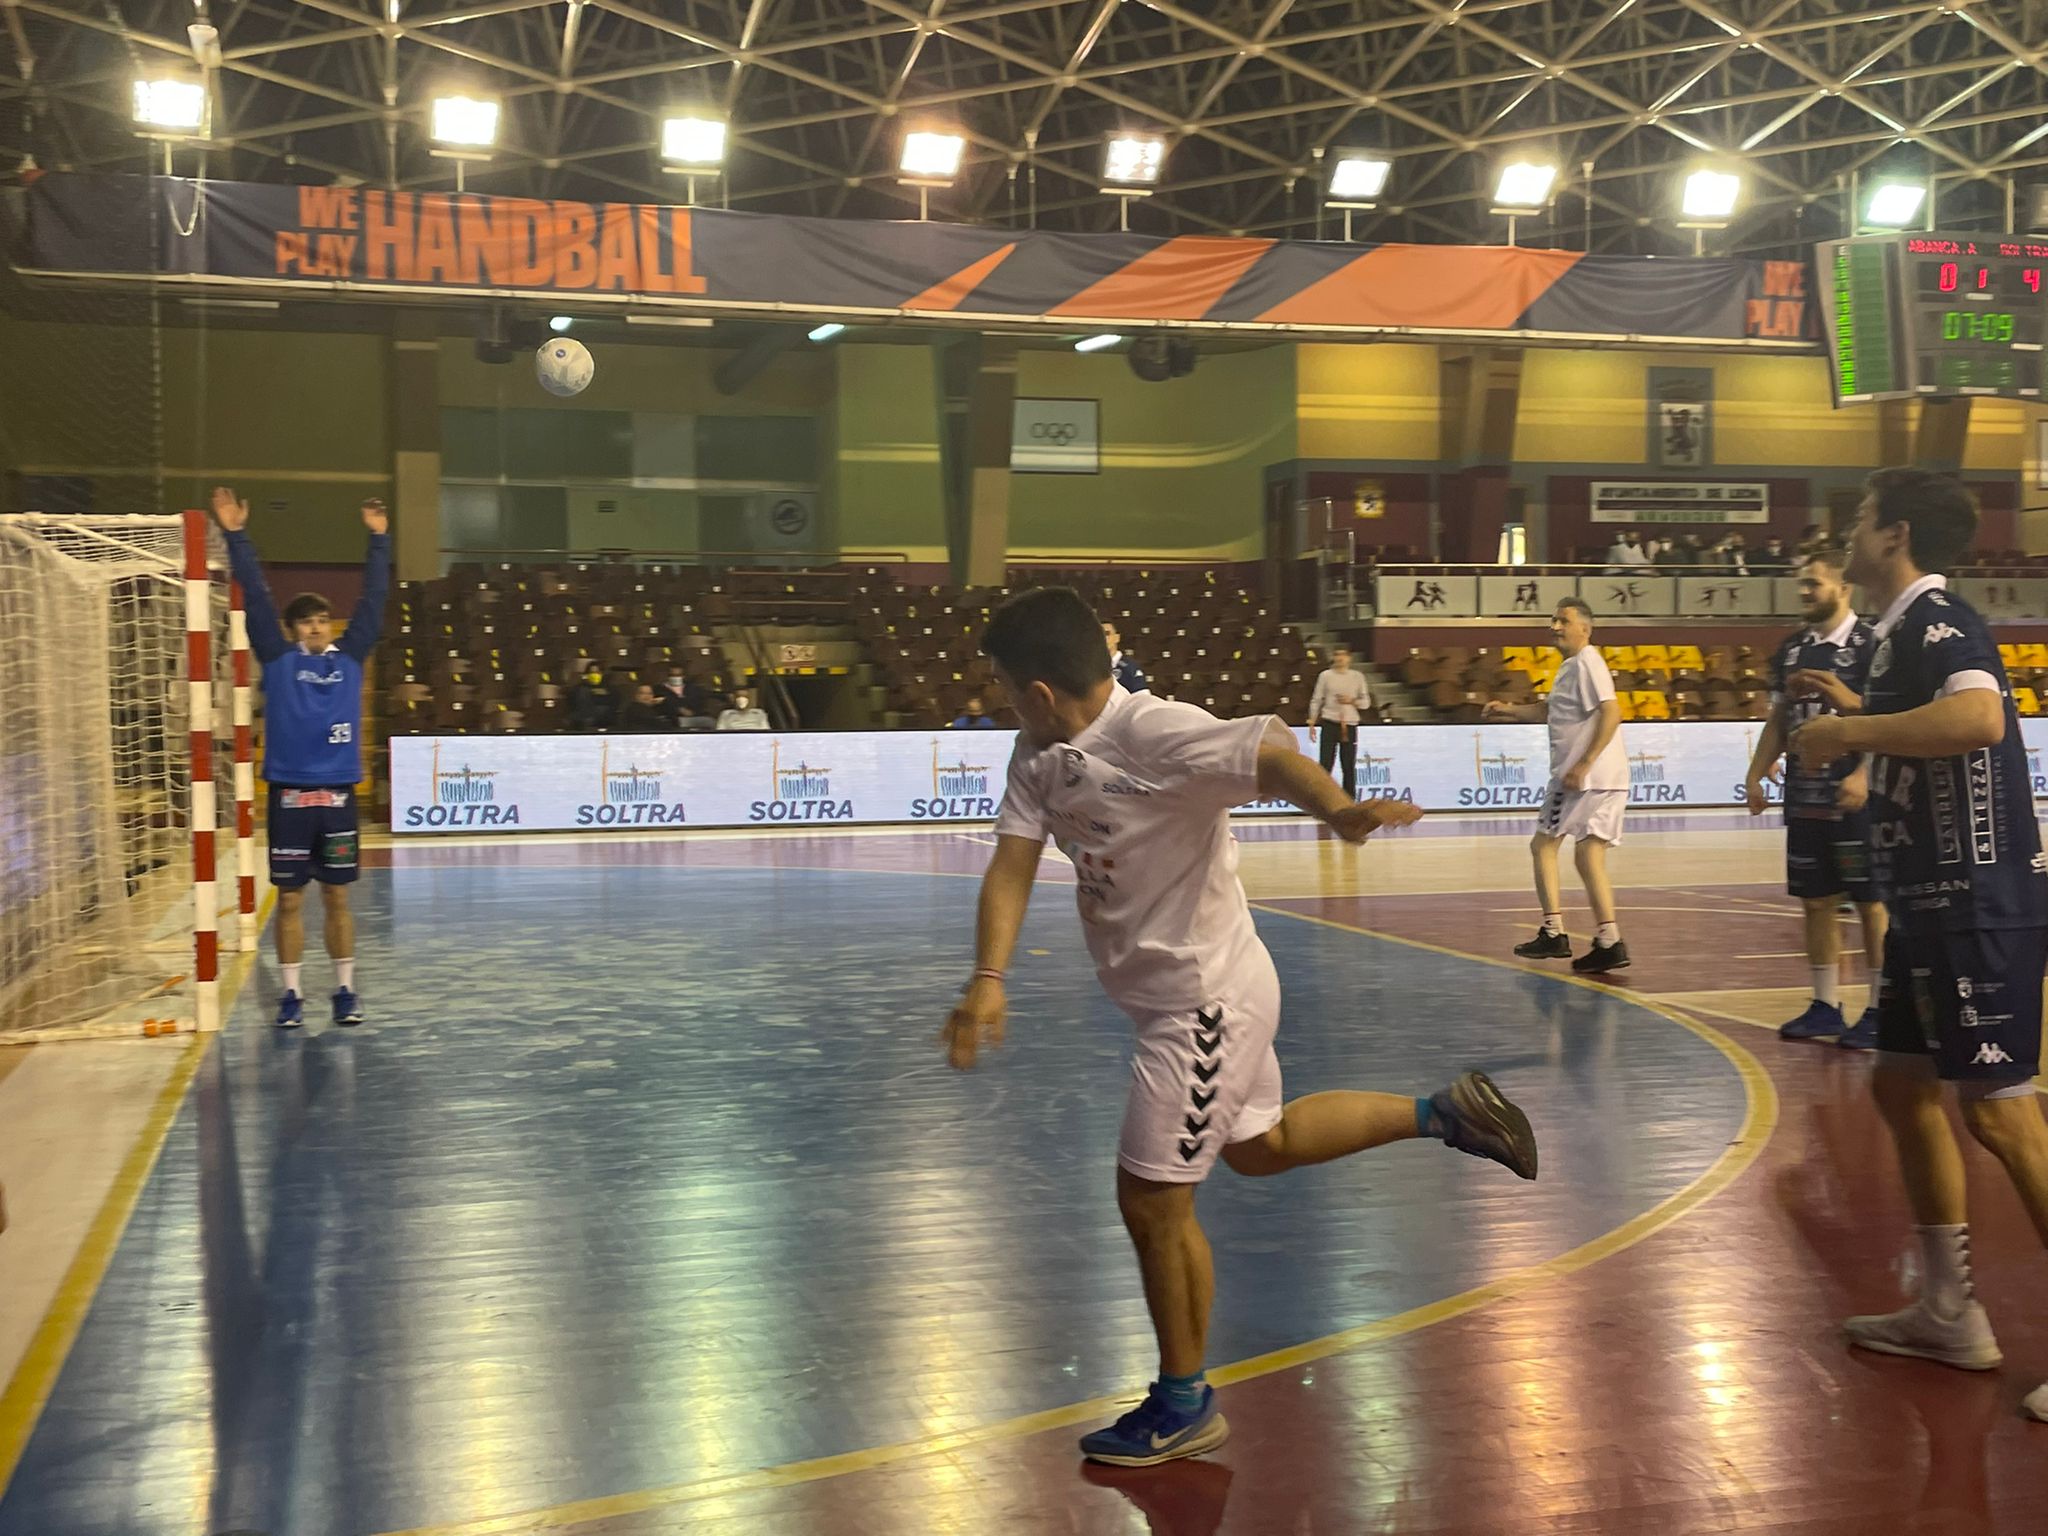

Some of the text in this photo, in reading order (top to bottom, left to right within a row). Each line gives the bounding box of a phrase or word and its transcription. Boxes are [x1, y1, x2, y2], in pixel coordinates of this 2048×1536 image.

[298, 185, 360, 230] WE
[275, 230, 359, 278] PLAY
[364, 189, 707, 294] HANDBALL
[1940, 262, 2041, 293] 0 1 4
[1943, 312, 2016, 341] 07:09
[405, 804, 520, 826] SOLTRA
[576, 803, 686, 825] SOLTRA
[750, 799, 854, 820] SOLTRA
